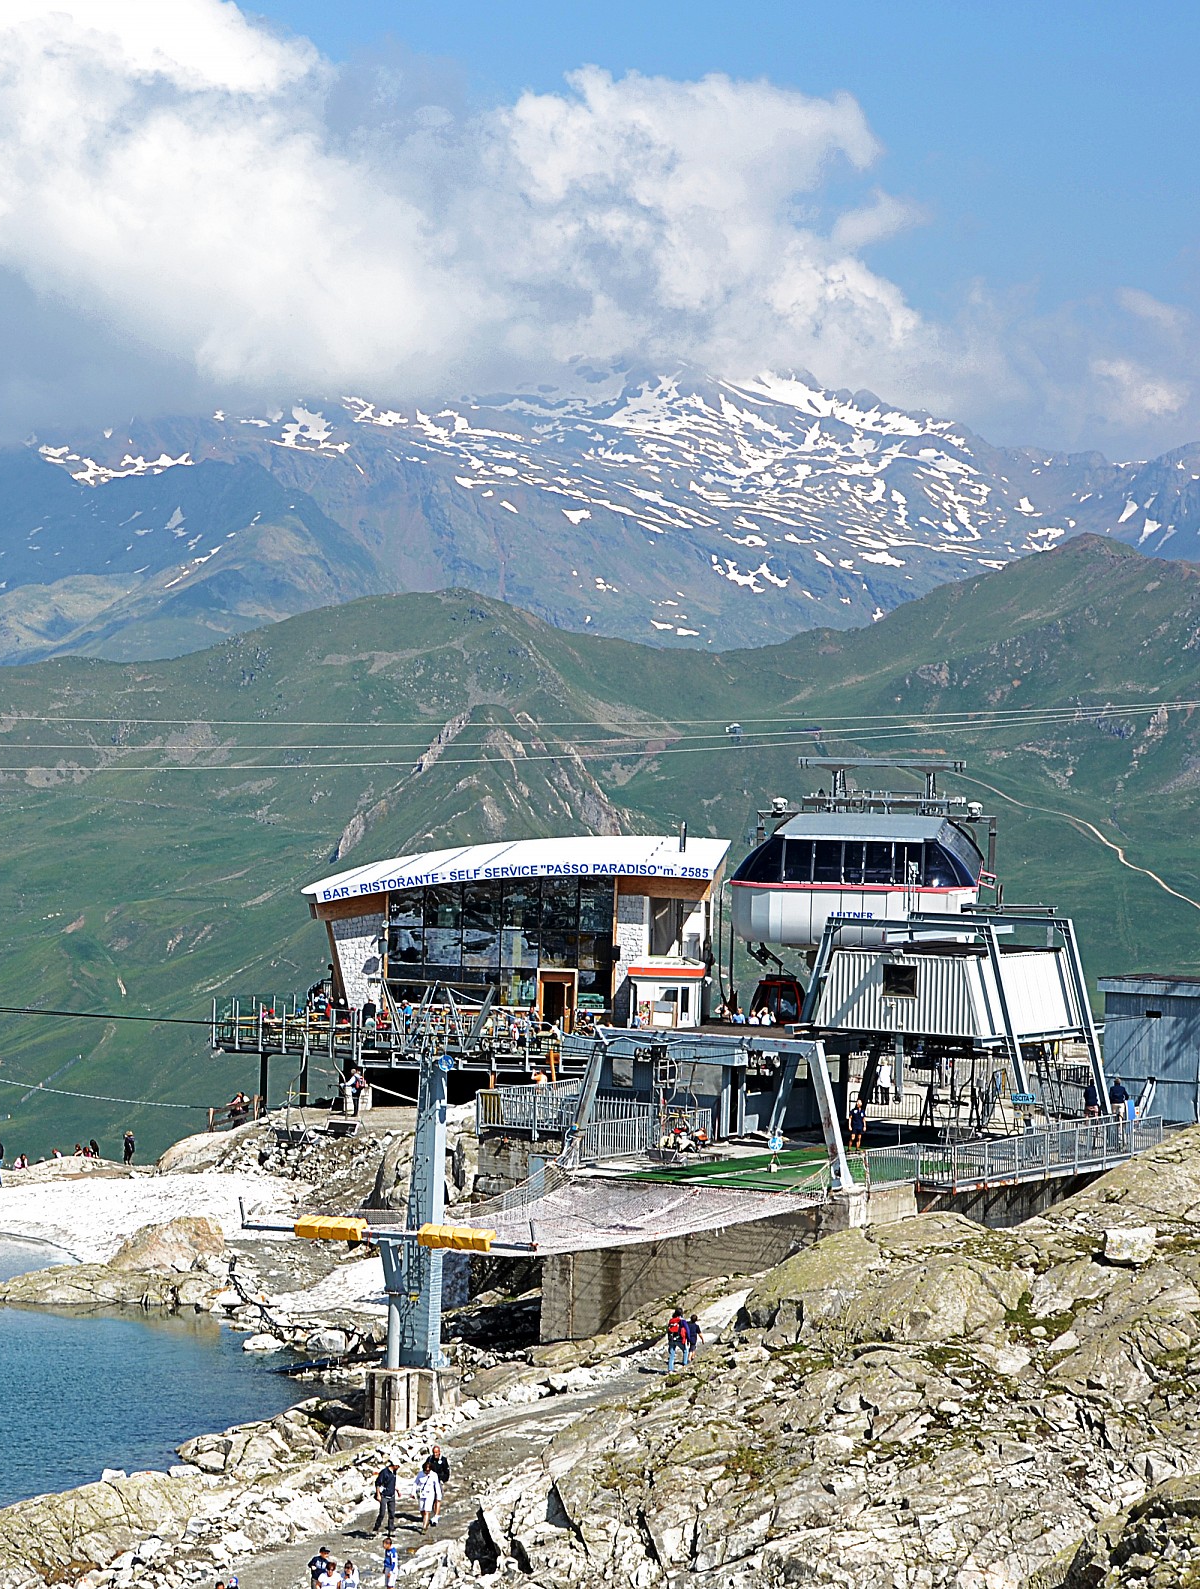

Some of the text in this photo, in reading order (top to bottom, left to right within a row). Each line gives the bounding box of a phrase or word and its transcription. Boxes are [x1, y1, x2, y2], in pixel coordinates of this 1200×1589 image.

[323, 886, 350, 901] BAR
[359, 873, 439, 894] RISTORANTE
[449, 868, 482, 882] SELF
[484, 865, 538, 878] SERVICE
[540, 863, 589, 875] "PASSO
[680, 866, 709, 879] 2585
